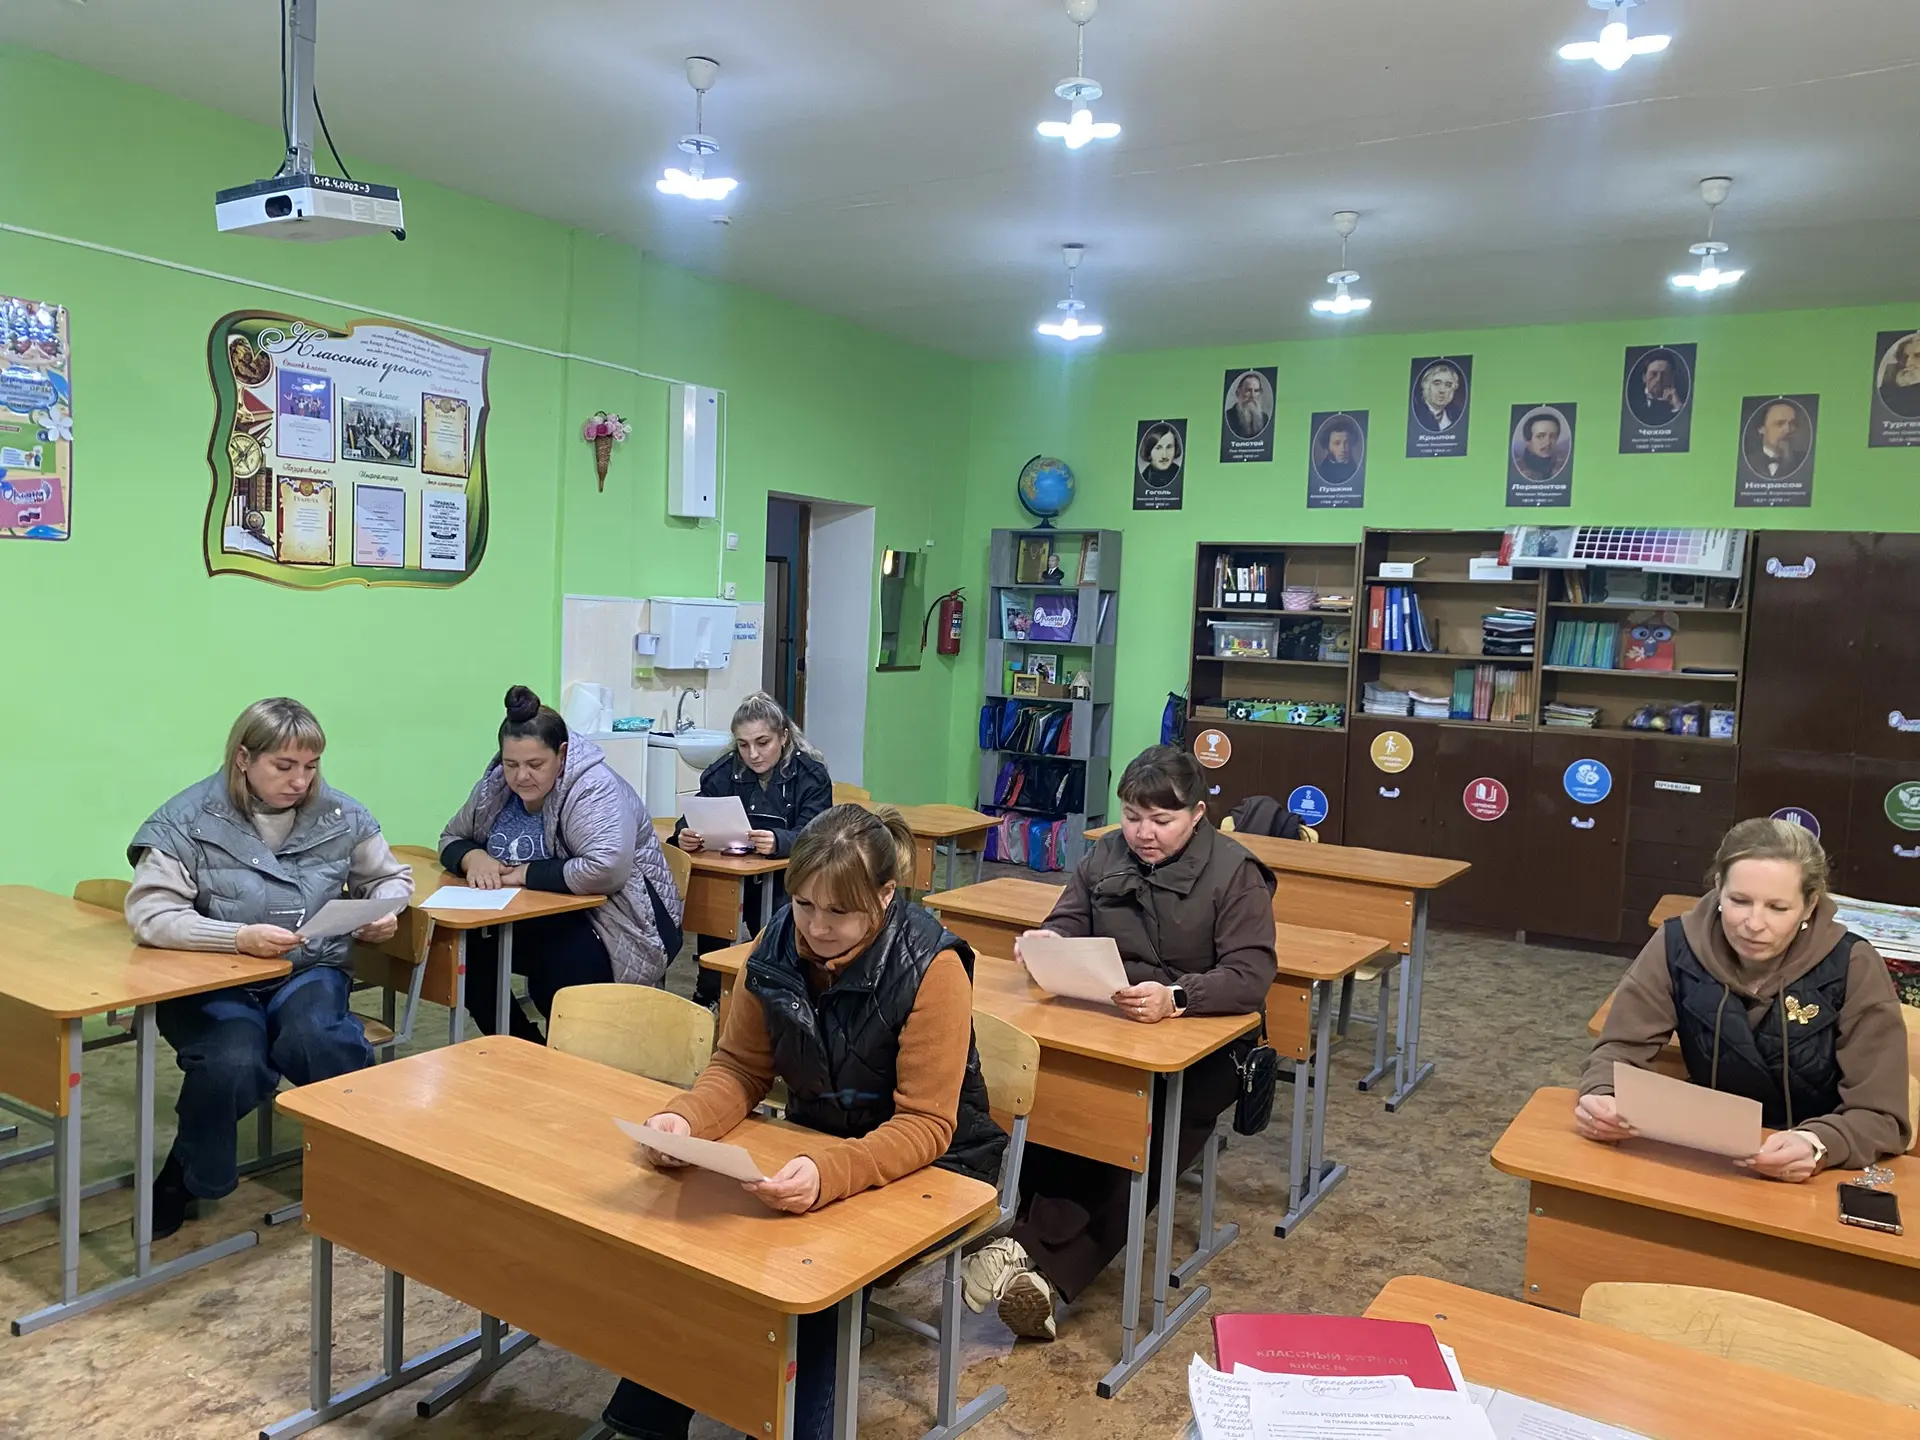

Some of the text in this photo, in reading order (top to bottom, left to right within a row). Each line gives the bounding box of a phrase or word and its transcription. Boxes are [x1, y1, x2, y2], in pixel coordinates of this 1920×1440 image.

[258, 321, 379, 368] Классный
[379, 361, 433, 383] уголок
[1419, 434, 1456, 442] Крылов
[1256, 1349, 1409, 1365] КЛАССНЫЙ ЖУРНАЛ
[1289, 1362, 1330, 1371] КЛАСС
